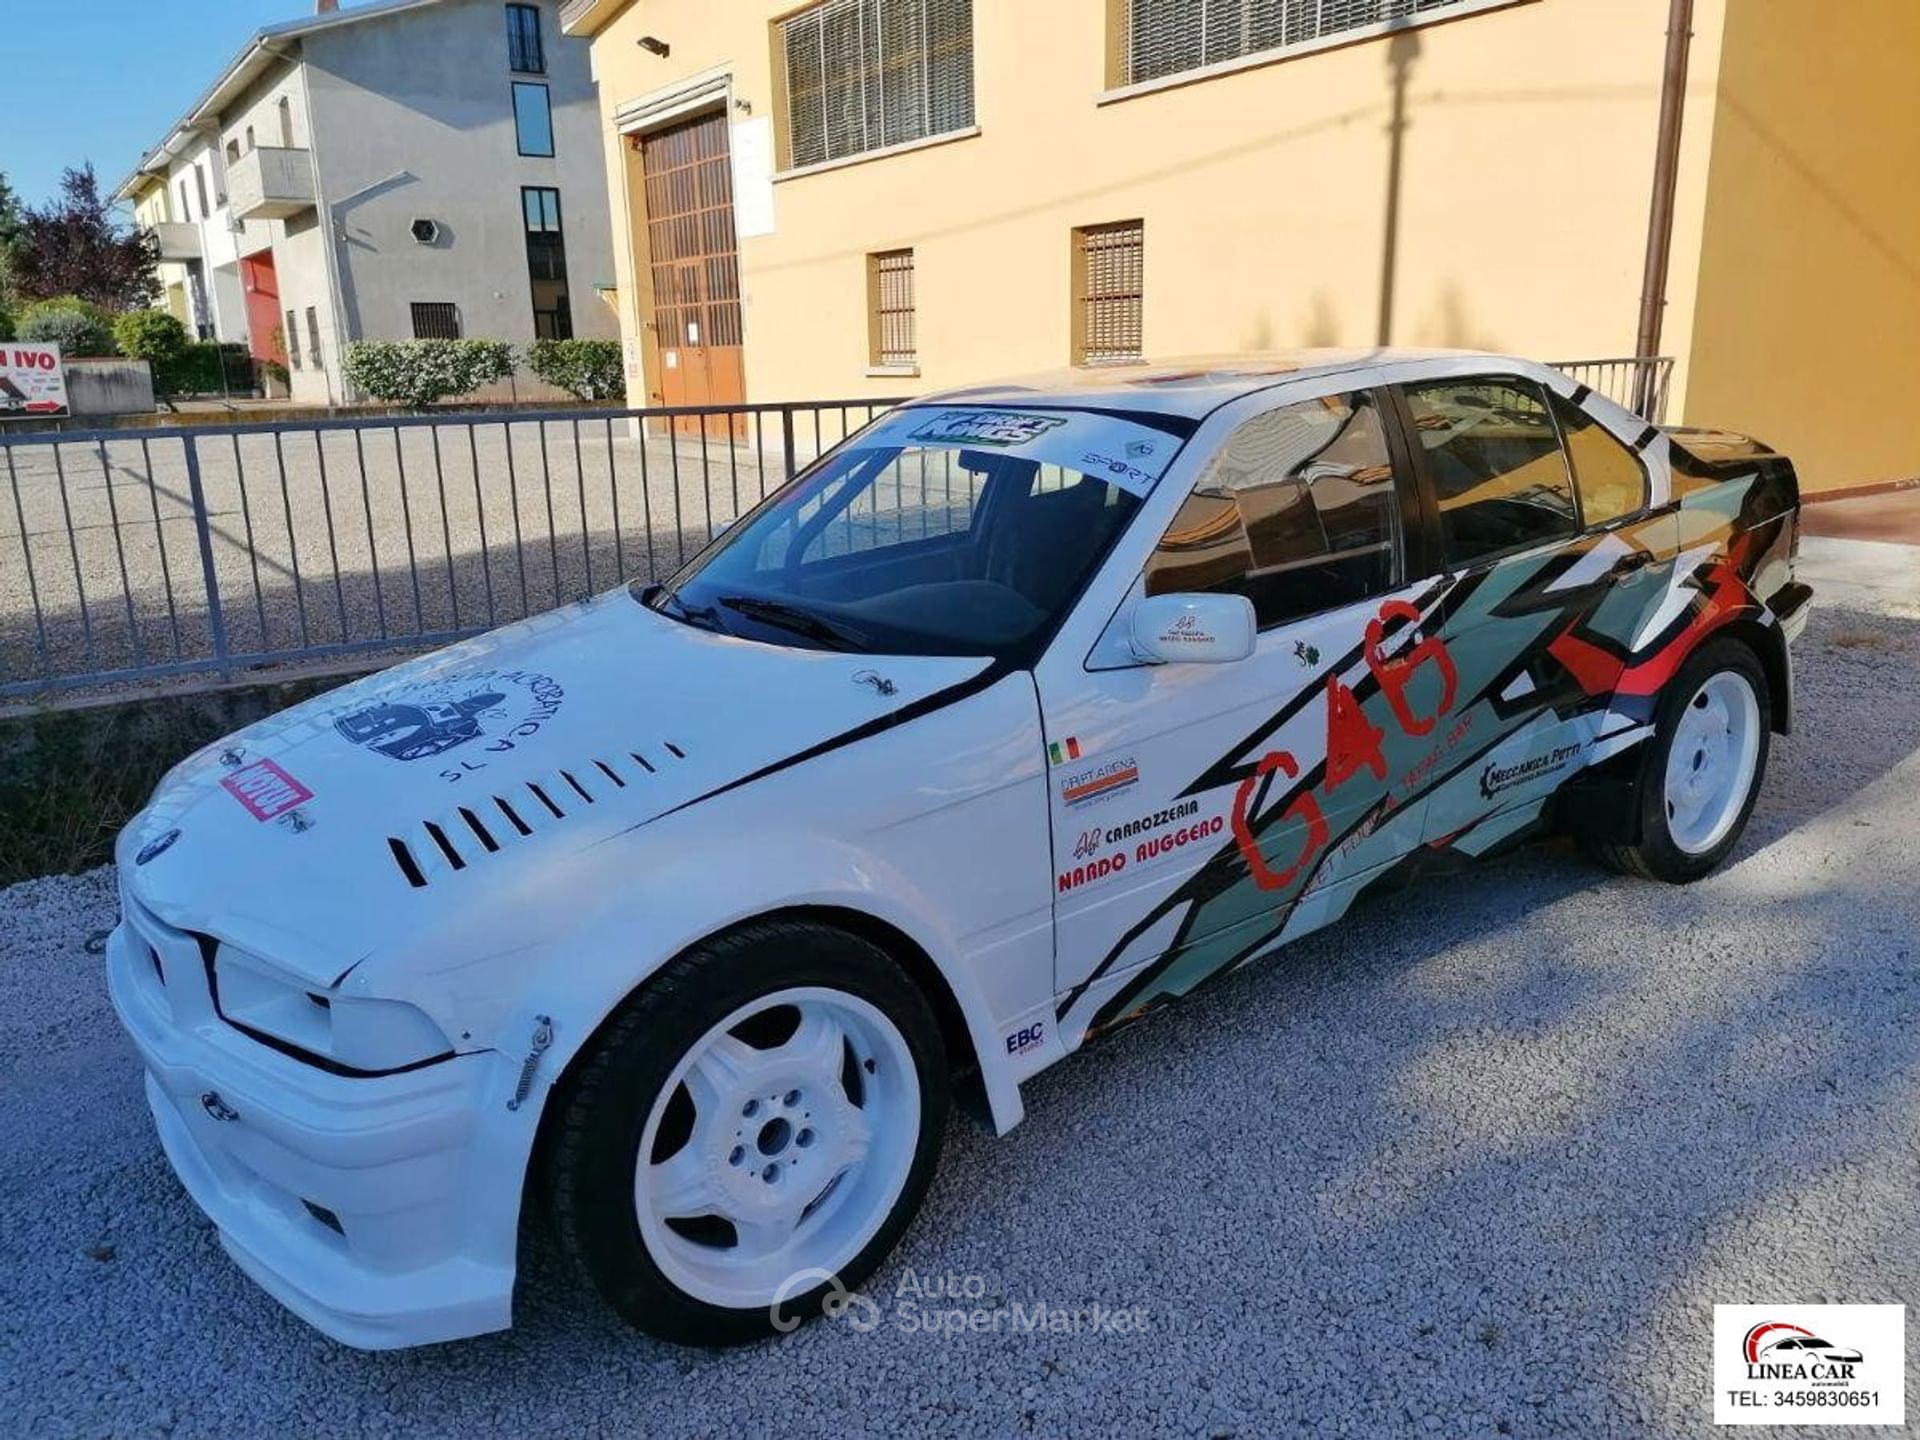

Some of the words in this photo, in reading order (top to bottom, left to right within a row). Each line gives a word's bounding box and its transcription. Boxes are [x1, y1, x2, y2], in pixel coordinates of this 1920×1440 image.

[14, 350, 56, 371] IVO
[1105, 799, 1199, 844] CARROZZERIA
[1058, 852, 1127, 893] NARDO
[1006, 1022, 1043, 1054] EBC
